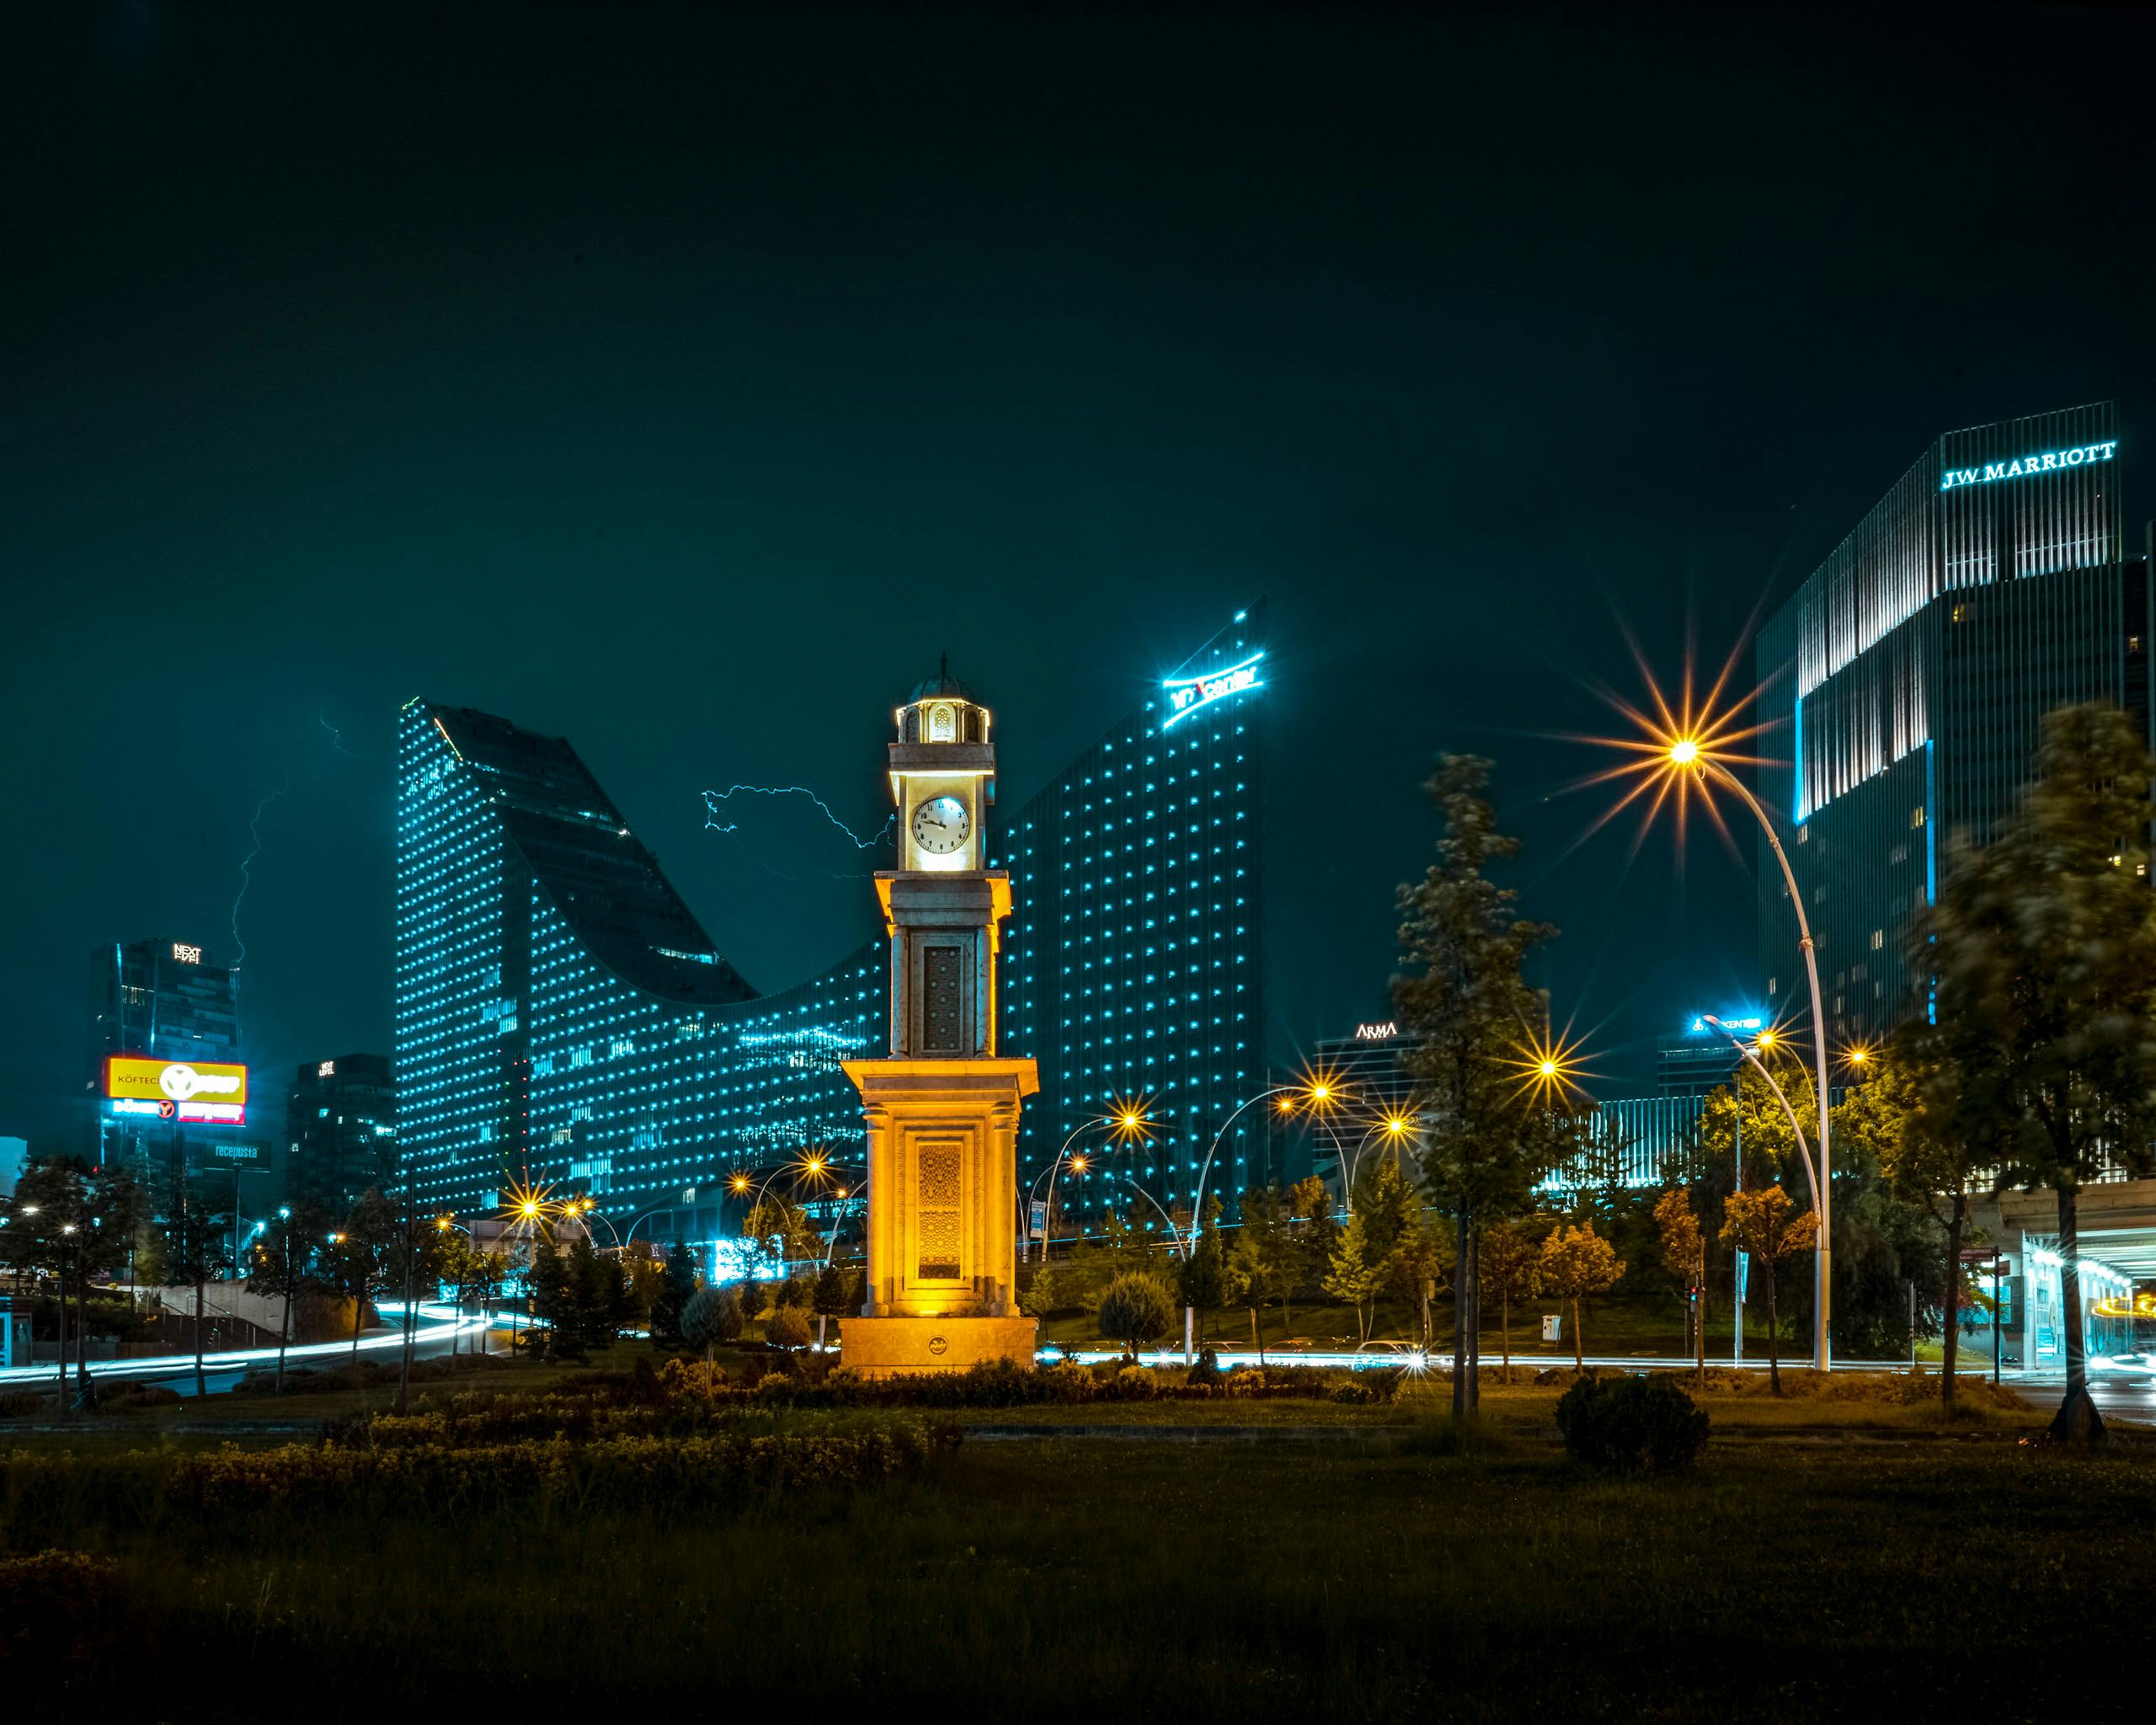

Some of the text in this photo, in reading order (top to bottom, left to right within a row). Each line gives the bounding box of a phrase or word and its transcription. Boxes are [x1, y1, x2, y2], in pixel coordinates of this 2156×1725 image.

[1943, 441, 2116, 489] JW MARRIOTT
[174, 943, 201, 956] NEXT
[1356, 1022, 1397, 1039] ARMA
